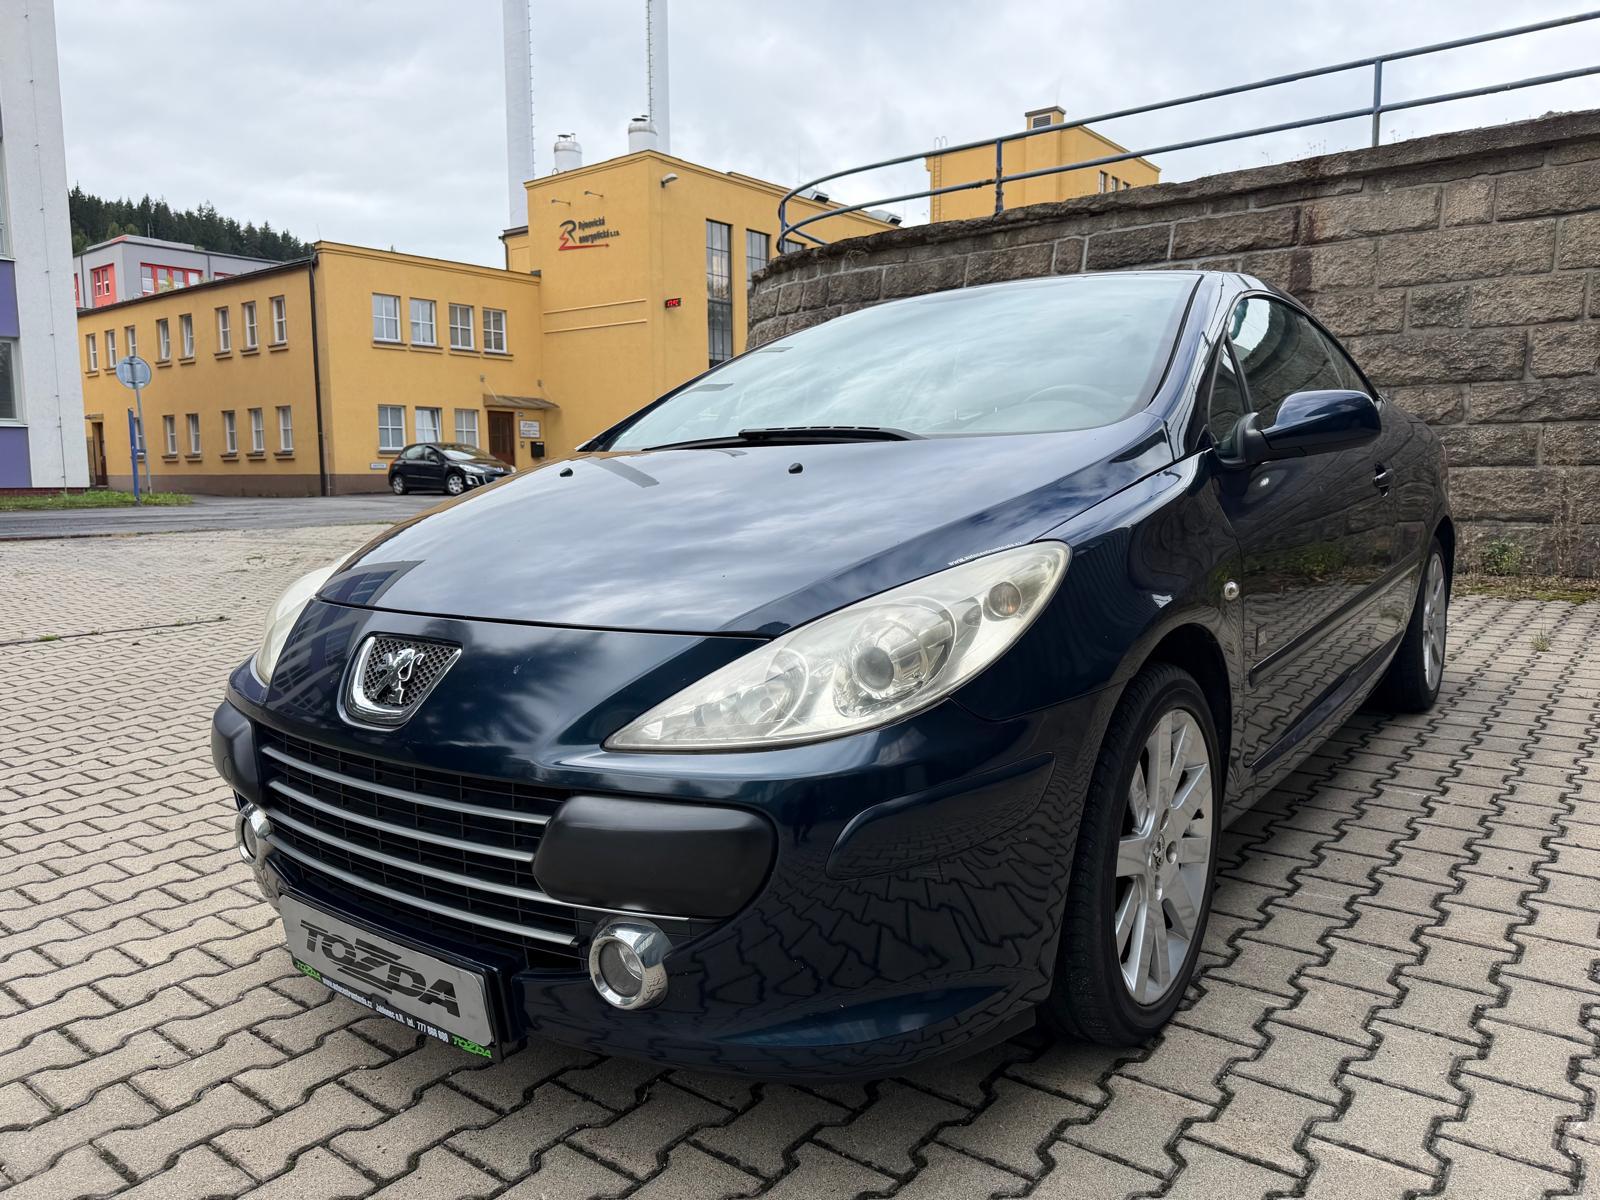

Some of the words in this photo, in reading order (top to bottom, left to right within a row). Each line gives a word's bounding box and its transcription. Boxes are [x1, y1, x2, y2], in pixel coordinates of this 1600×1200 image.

[294, 959, 321, 981] TOZDA
[300, 919, 461, 1018] TOZDA
[416, 1020, 427, 1033] 777
[452, 1035, 492, 1059] TOZDA
